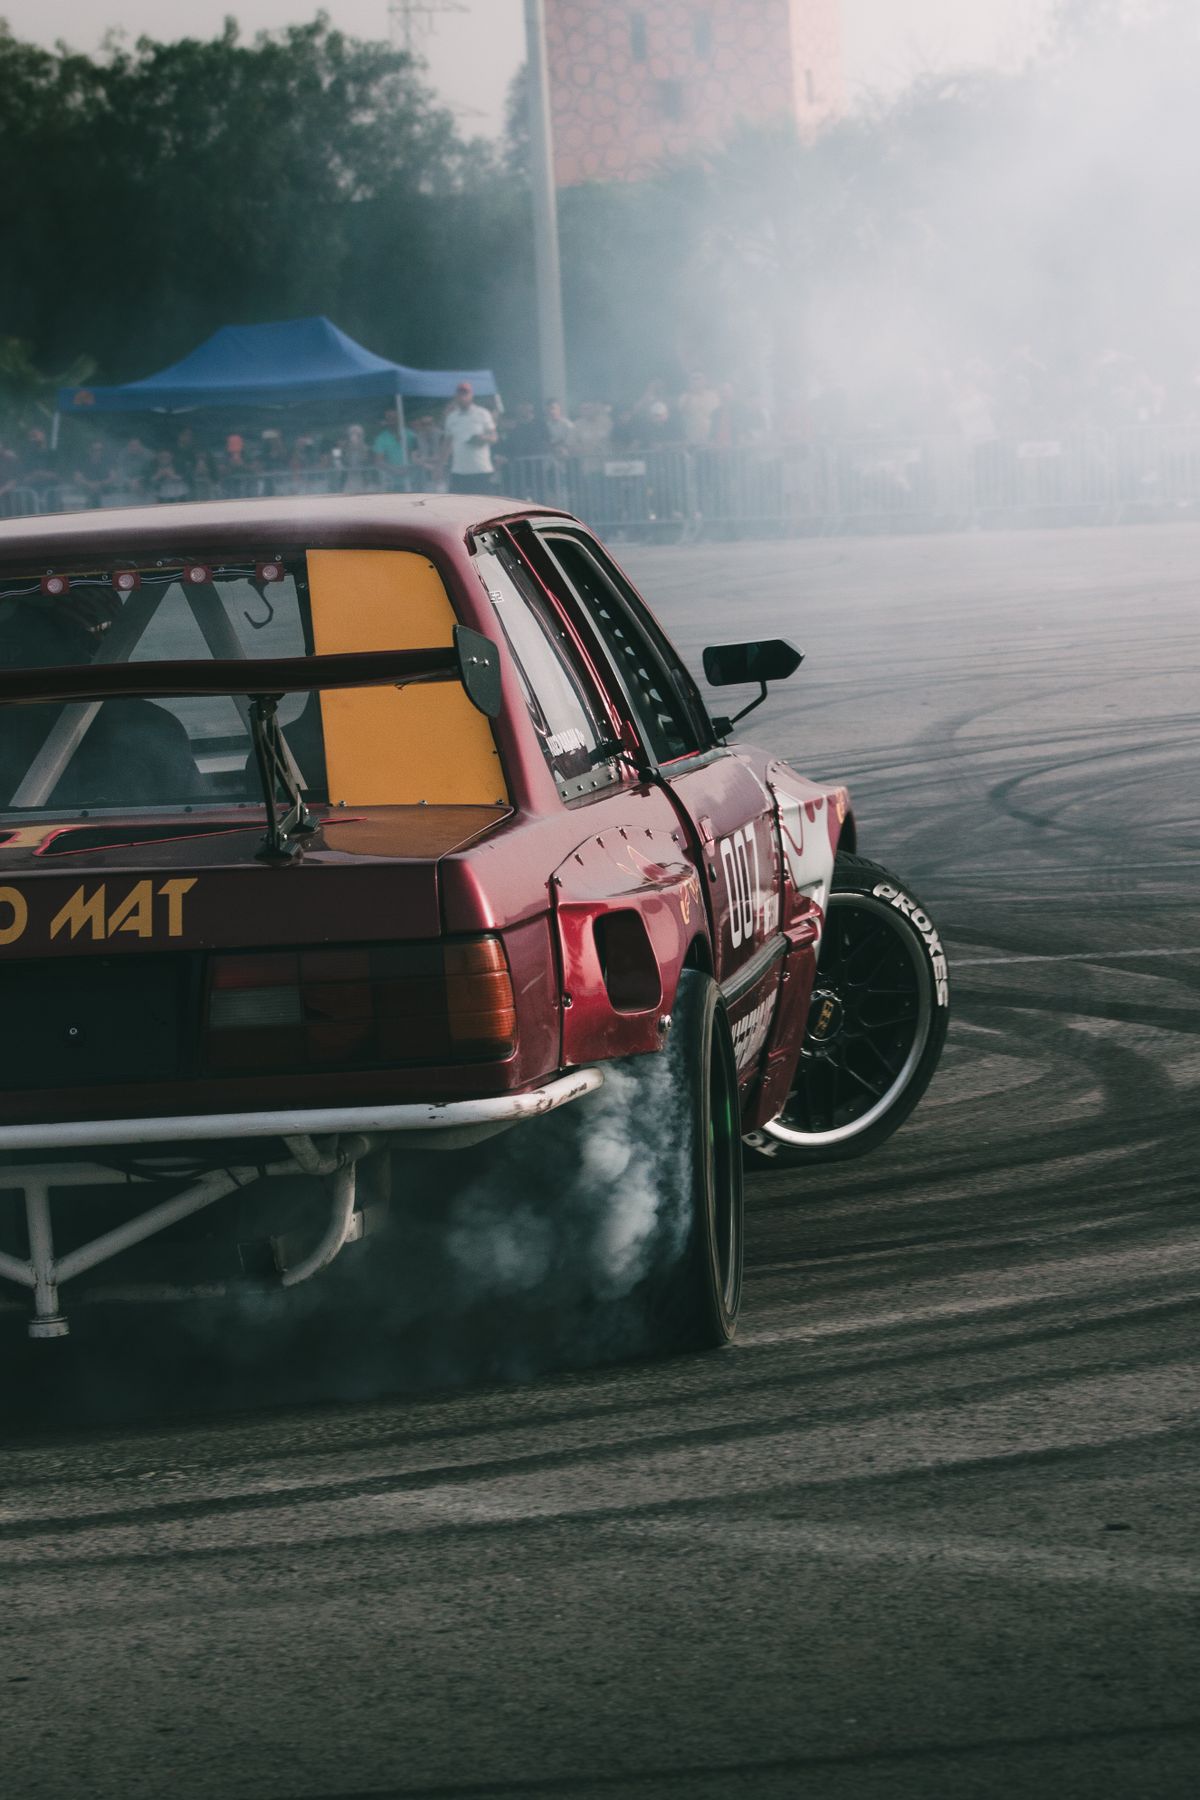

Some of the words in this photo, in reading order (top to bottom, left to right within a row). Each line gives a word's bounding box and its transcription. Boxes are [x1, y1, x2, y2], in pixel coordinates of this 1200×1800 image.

[50, 878, 198, 939] MAT
[720, 822, 760, 949] 007
[872, 884, 949, 1007] PROXES
